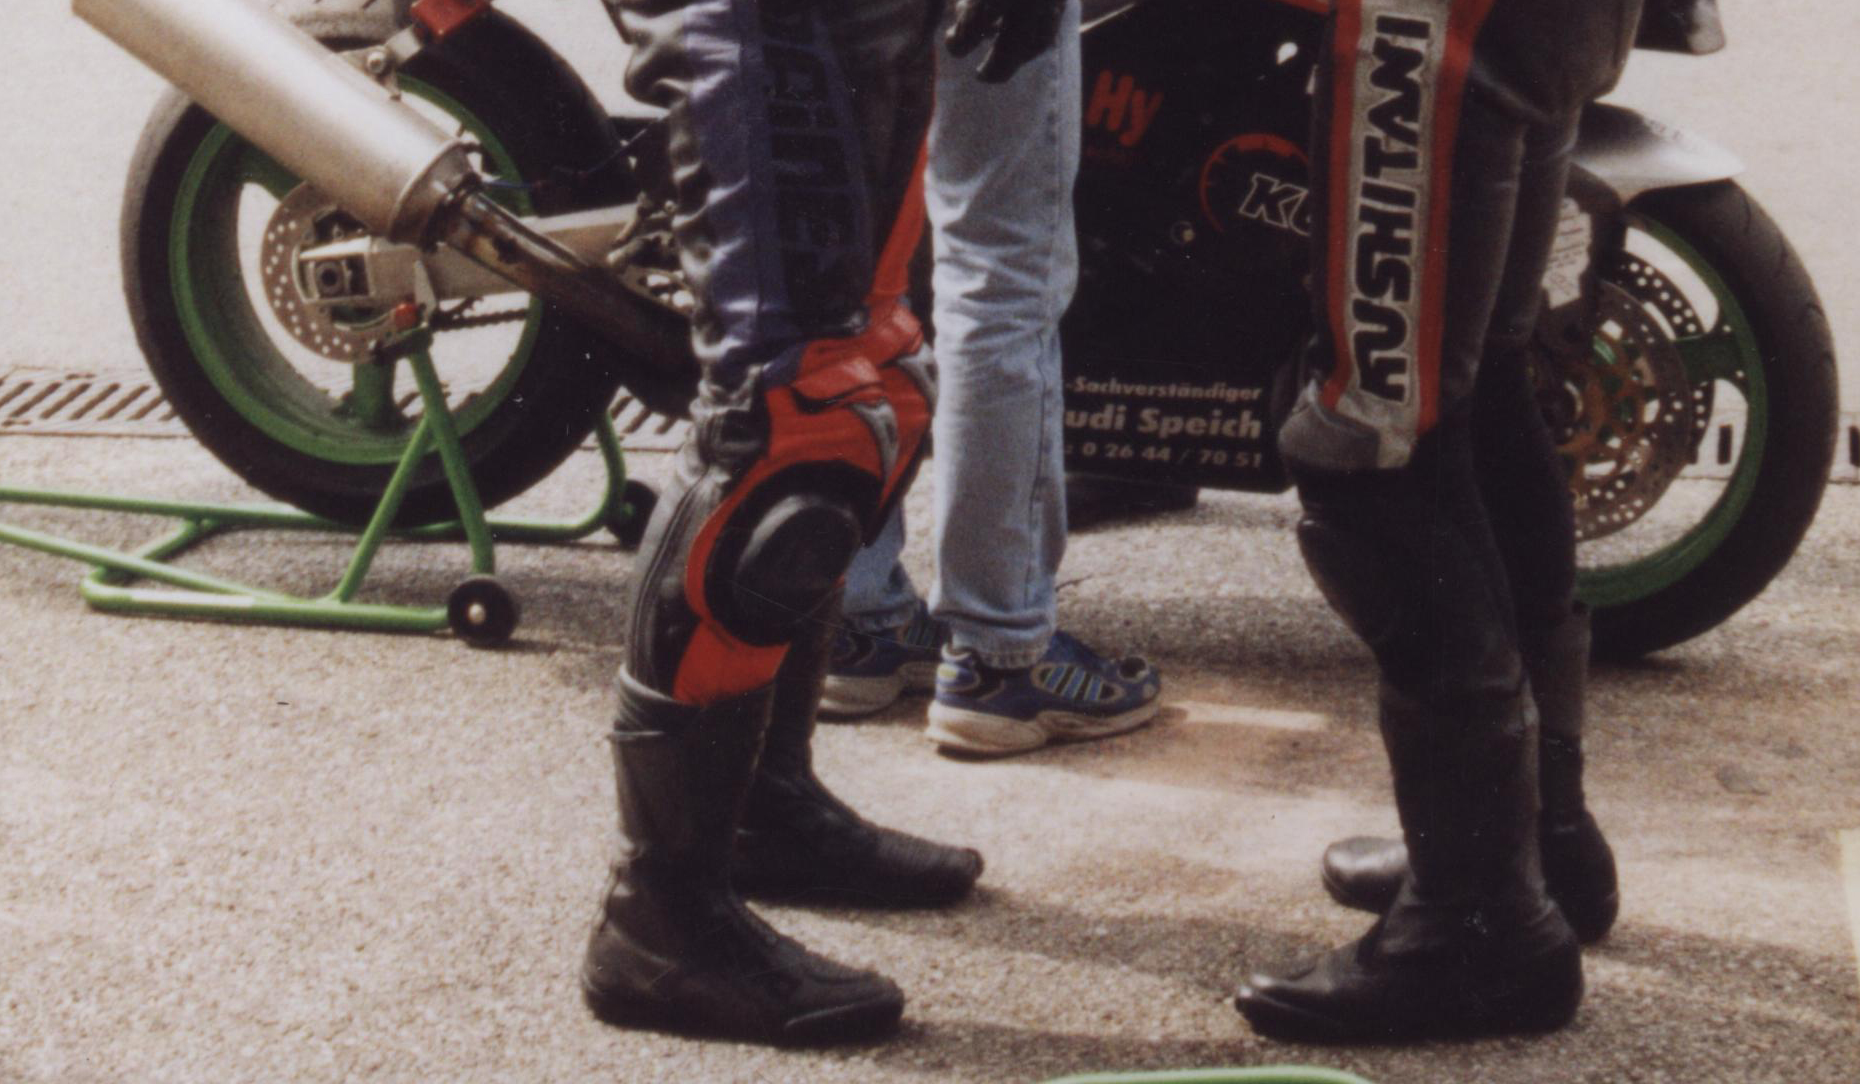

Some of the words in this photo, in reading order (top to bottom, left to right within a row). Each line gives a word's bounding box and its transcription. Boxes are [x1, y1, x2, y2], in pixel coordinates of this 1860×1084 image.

[1064, 404, 1128, 431] udi
[1137, 407, 1262, 440] Speich
[1105, 443, 1133, 459] 26
[1142, 446, 1171, 462] 44
[1200, 450, 1227, 466] 70
[1235, 452, 1263, 468] 51
